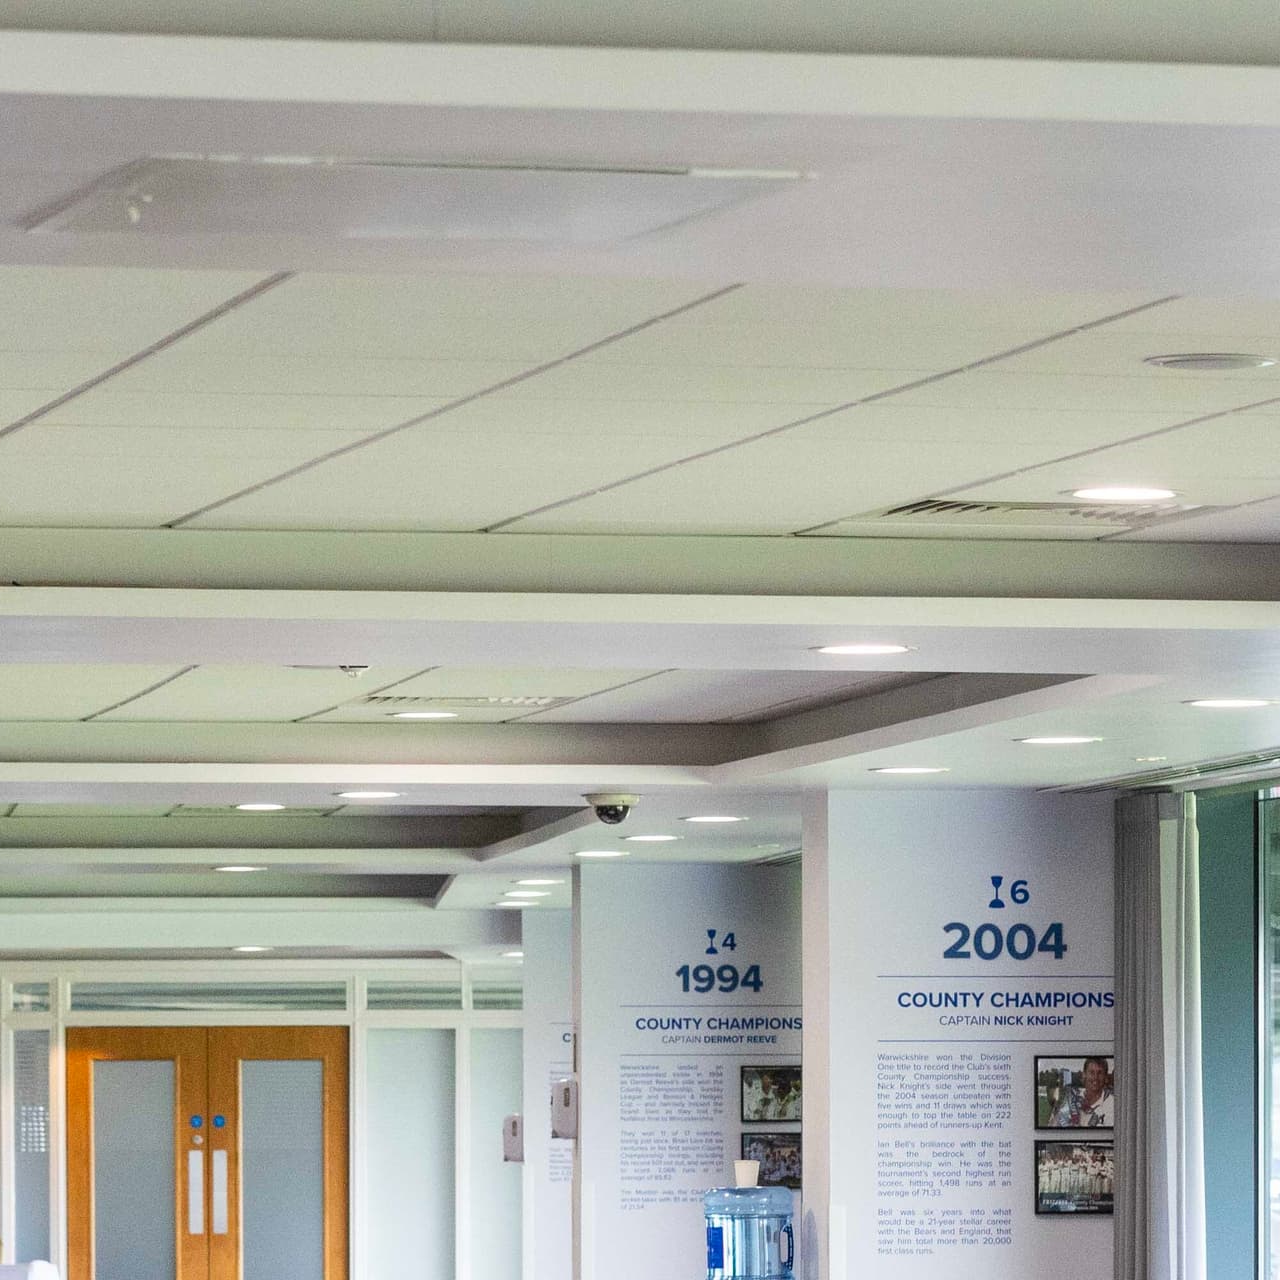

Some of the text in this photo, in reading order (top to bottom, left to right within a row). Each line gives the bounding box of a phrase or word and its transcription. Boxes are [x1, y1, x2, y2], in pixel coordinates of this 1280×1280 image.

[1010, 880, 1030, 904] 6
[722, 933, 737, 951] 4
[943, 922, 1067, 960] 2004
[675, 964, 763, 993] 1994
[897, 992, 1114, 1008] COUNTY CHAMPIONS
[635, 1018, 802, 1030] COUNTY CHAMPIONS
[939, 1015, 1073, 1026] CAPTAIN NICK KNIGHT
[662, 1035, 701, 1043] CAPTAIN
[877, 1053, 929, 1061] Warwickshire
[960, 1053, 973, 1061] the
[980, 1053, 1012, 1061] Division
[877, 1063, 895, 1071] One
[896, 1063, 911, 1071] title
[913, 1063, 922, 1071] to
[923, 1063, 950, 1071] record
[951, 1063, 965, 1071] the
[992, 1063, 1012, 1071] sixth
[877, 1072, 906, 1082] County
[913, 1072, 970, 1082] Championship
[877, 1082, 895, 1090] Nick
[935, 1082, 952, 1090] side
[956, 1082, 976, 1090] went
[980, 1082, 1012, 1092] through
[877, 1092, 890, 1100] the
[895, 1092, 916, 1100] 2004
[953, 1092, 991, 1100] unbeaten
[994, 1092, 1012, 1100] with
[877, 1101, 892, 1109] five
[915, 1101, 931, 1109] and
[933, 1101, 940, 1109] 11
[942, 1101, 967, 1109] draws
[969, 1101, 993, 1109] which
